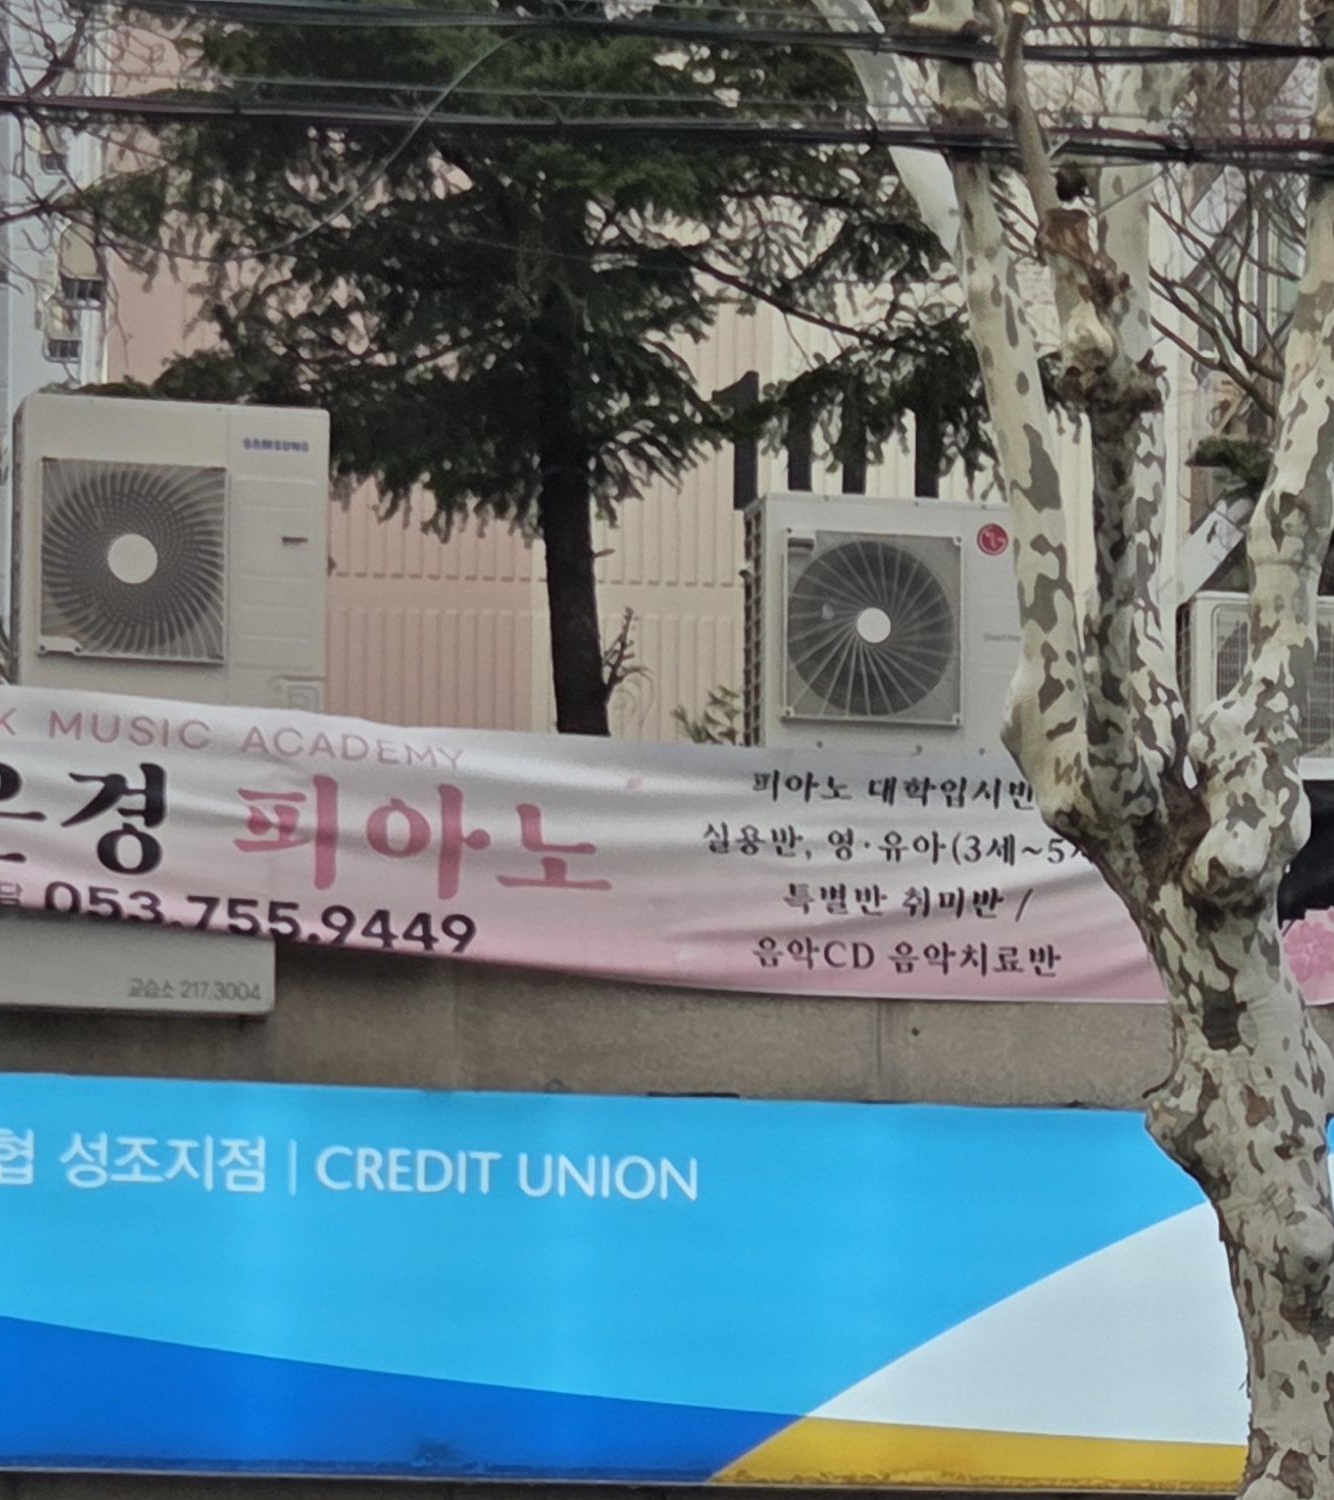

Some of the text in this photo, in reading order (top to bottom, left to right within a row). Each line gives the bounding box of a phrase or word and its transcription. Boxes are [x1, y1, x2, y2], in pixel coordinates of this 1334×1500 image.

[47, 708, 213, 752] MUSIC
[240, 724, 465, 770] ACADEMY
[752, 770, 854, 803] 피아노
[232, 773, 612, 901] 피아노
[703, 821, 813, 861] 실용반,
[44, 881, 478, 954] 053.755.9449
[783, 882, 888, 917] 특별반
[902, 885, 1005, 920] 취미반
[751, 935, 1062, 978] 음악CD 음악치료반
[58, 1126, 268, 1194] 성조지점
[316, 1143, 502, 1197] CREDIT
[517, 1148, 699, 1202] UNION
